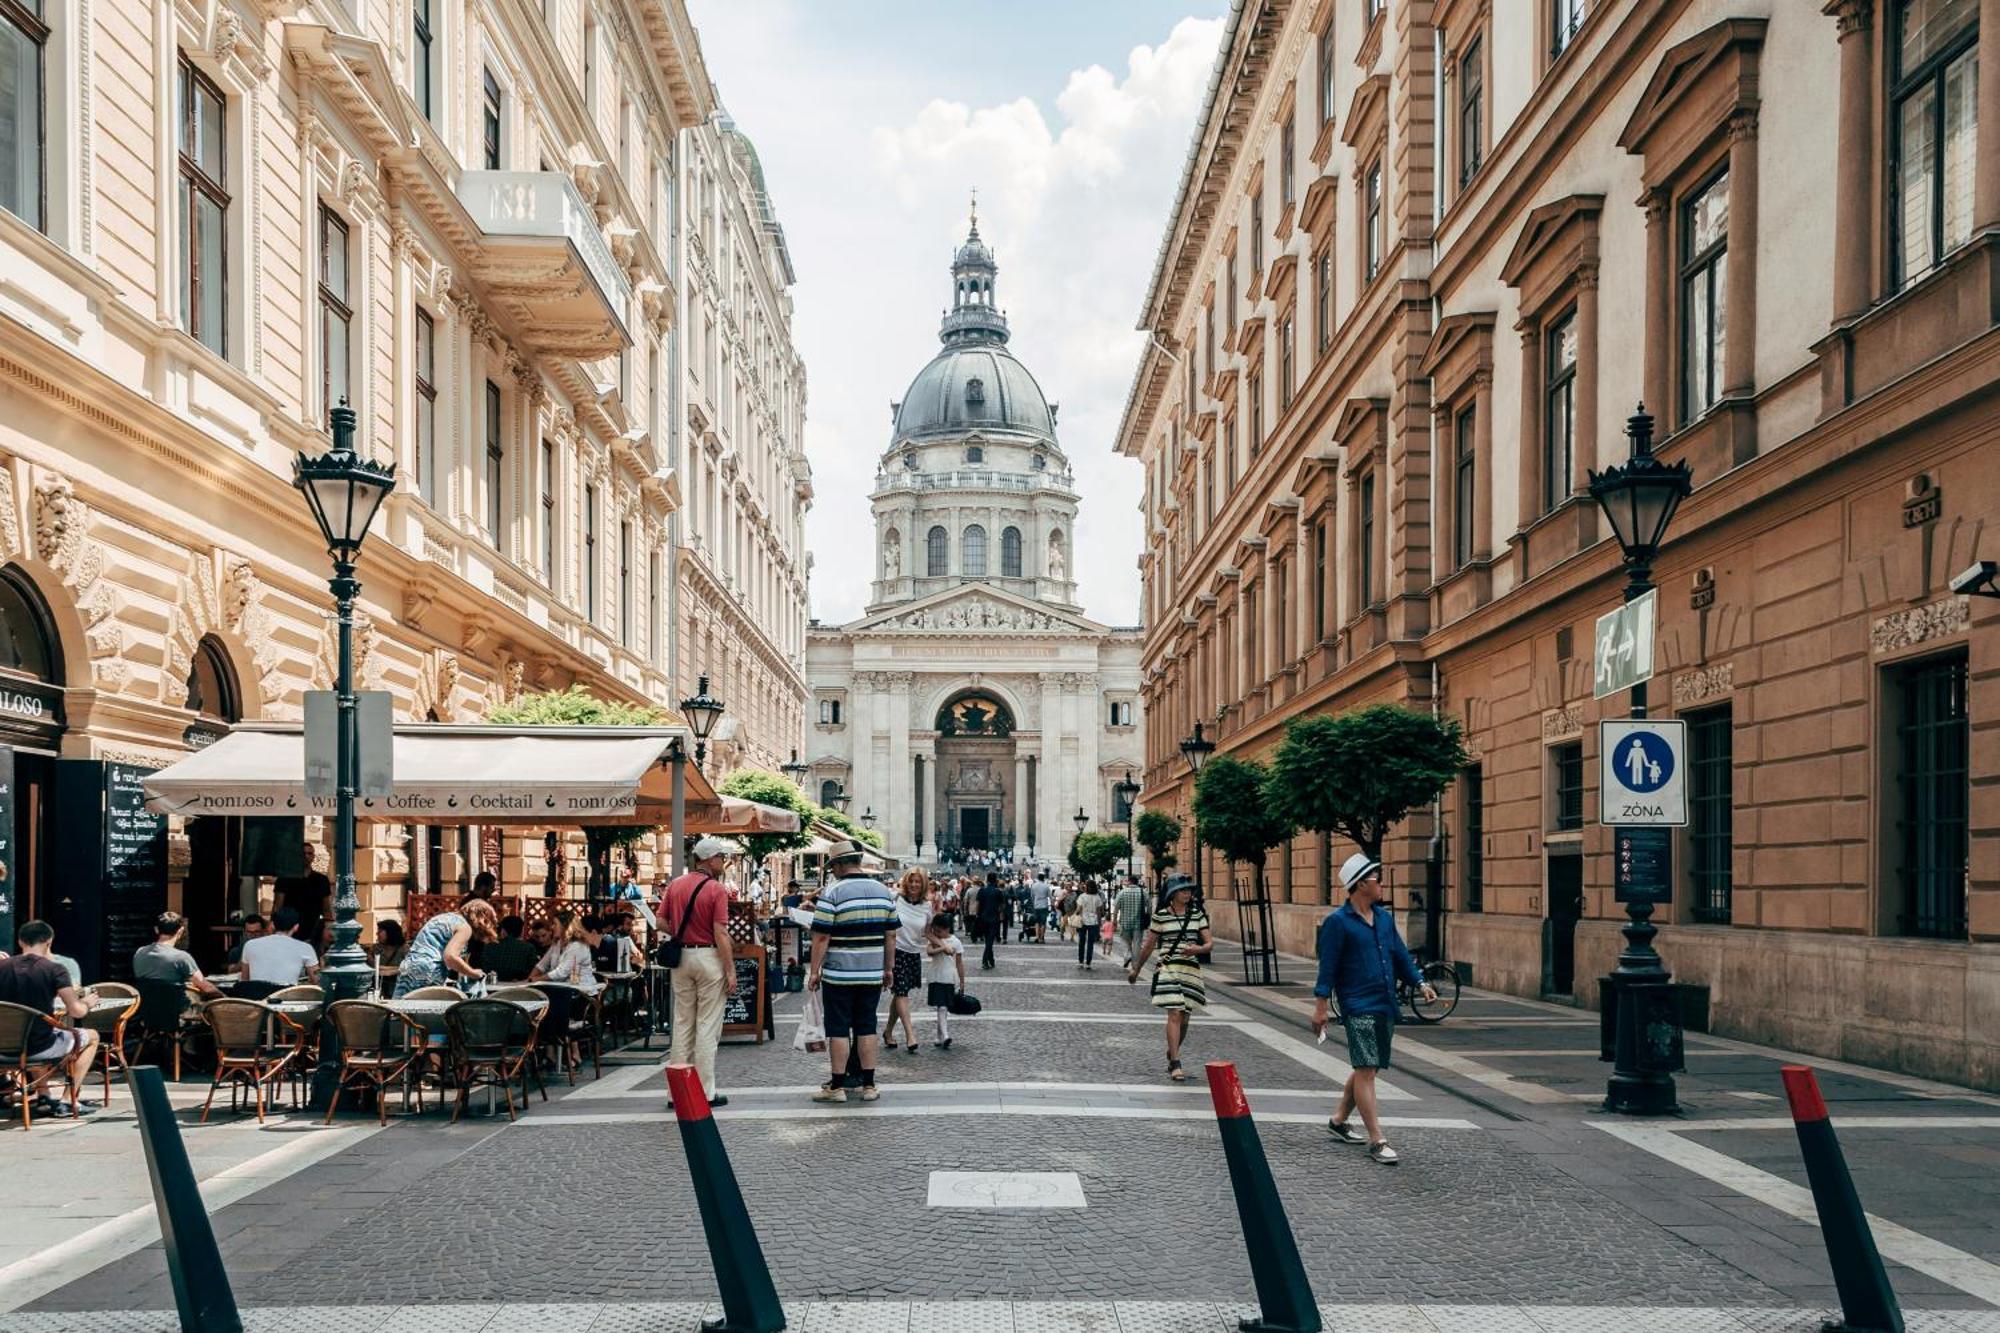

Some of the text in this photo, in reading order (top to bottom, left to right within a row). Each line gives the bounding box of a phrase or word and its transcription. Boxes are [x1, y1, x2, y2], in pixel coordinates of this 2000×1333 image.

[386, 793, 436, 809] Coffee
[470, 793, 533, 809] Cocktail
[1622, 801, 1665, 817] ZÓNA
